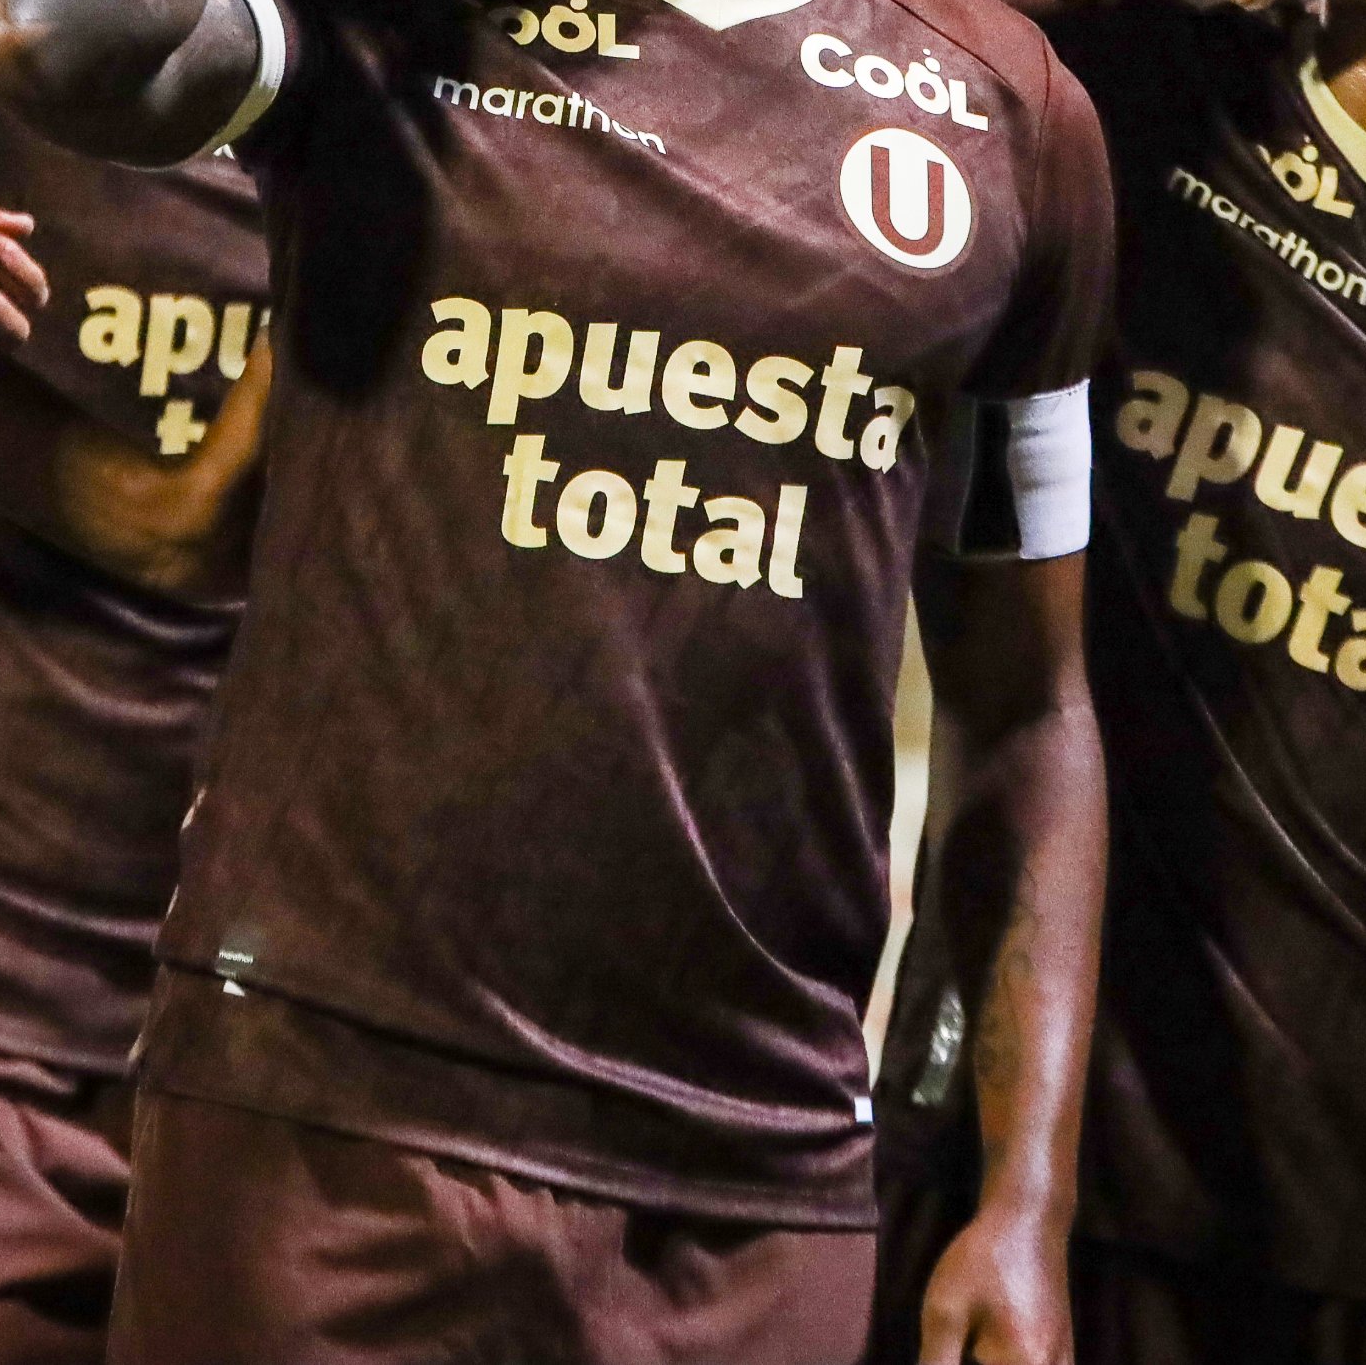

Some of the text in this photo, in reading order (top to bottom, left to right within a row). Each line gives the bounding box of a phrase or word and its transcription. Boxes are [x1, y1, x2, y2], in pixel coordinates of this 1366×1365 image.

[433, 75, 666, 154] marathon
[870, 145, 944, 256] U
[421, 297, 915, 474] apuesta
[500, 434, 807, 598] total
